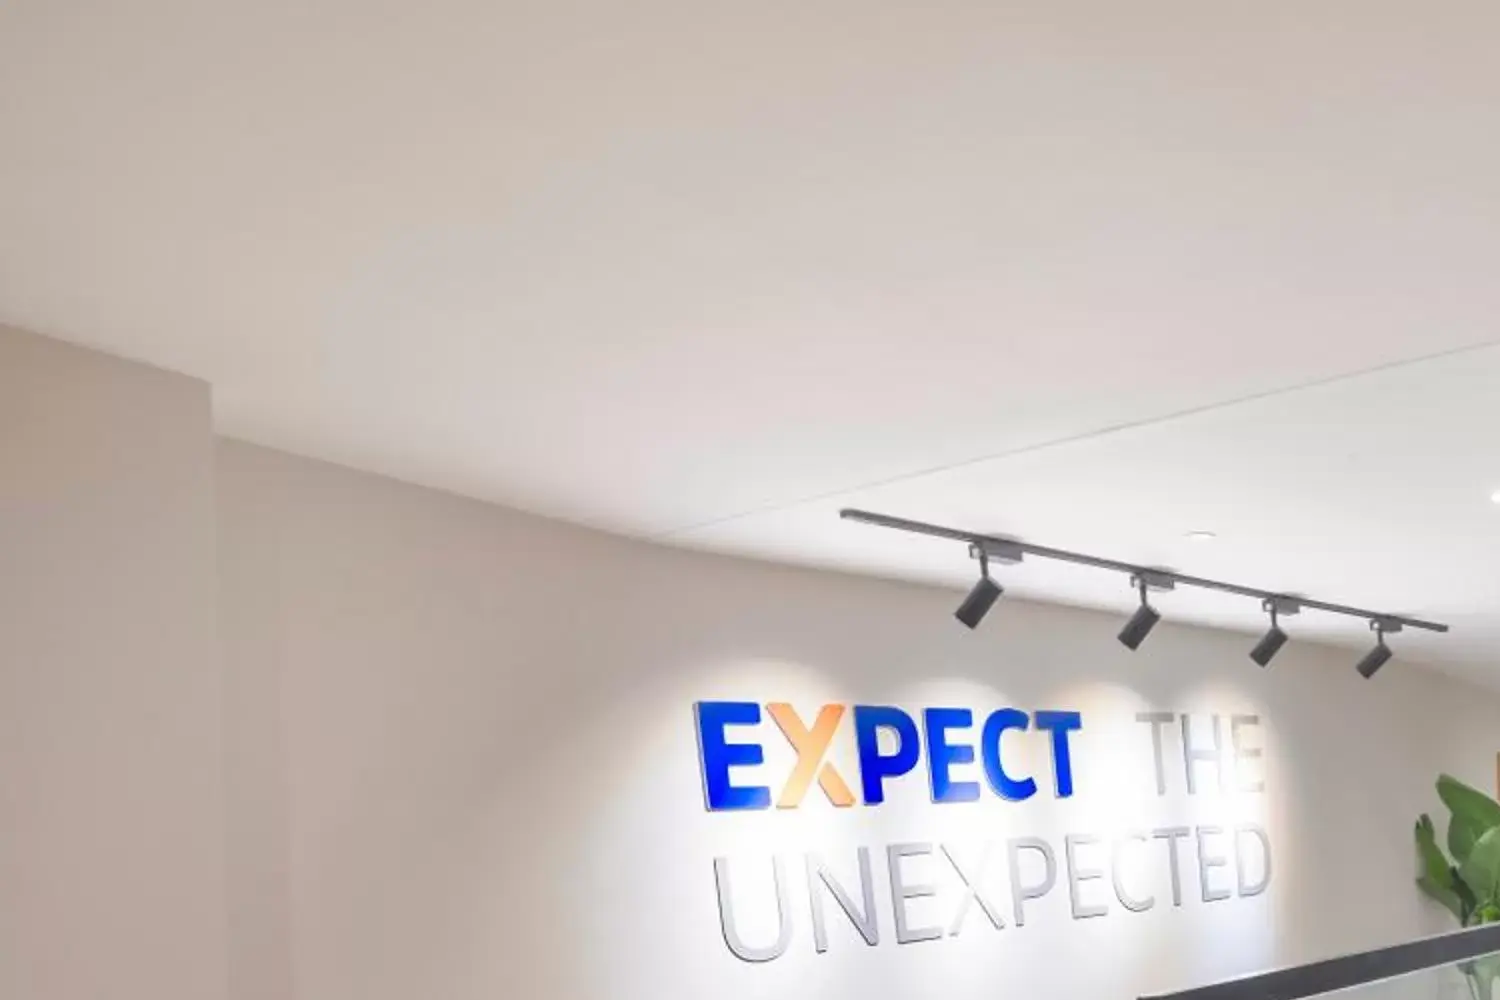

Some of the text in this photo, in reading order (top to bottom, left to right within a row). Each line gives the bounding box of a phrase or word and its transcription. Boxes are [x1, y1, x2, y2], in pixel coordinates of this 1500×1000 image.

[692, 700, 1266, 812] EXPECT THE
[713, 822, 1274, 963] UNEXPECTED
